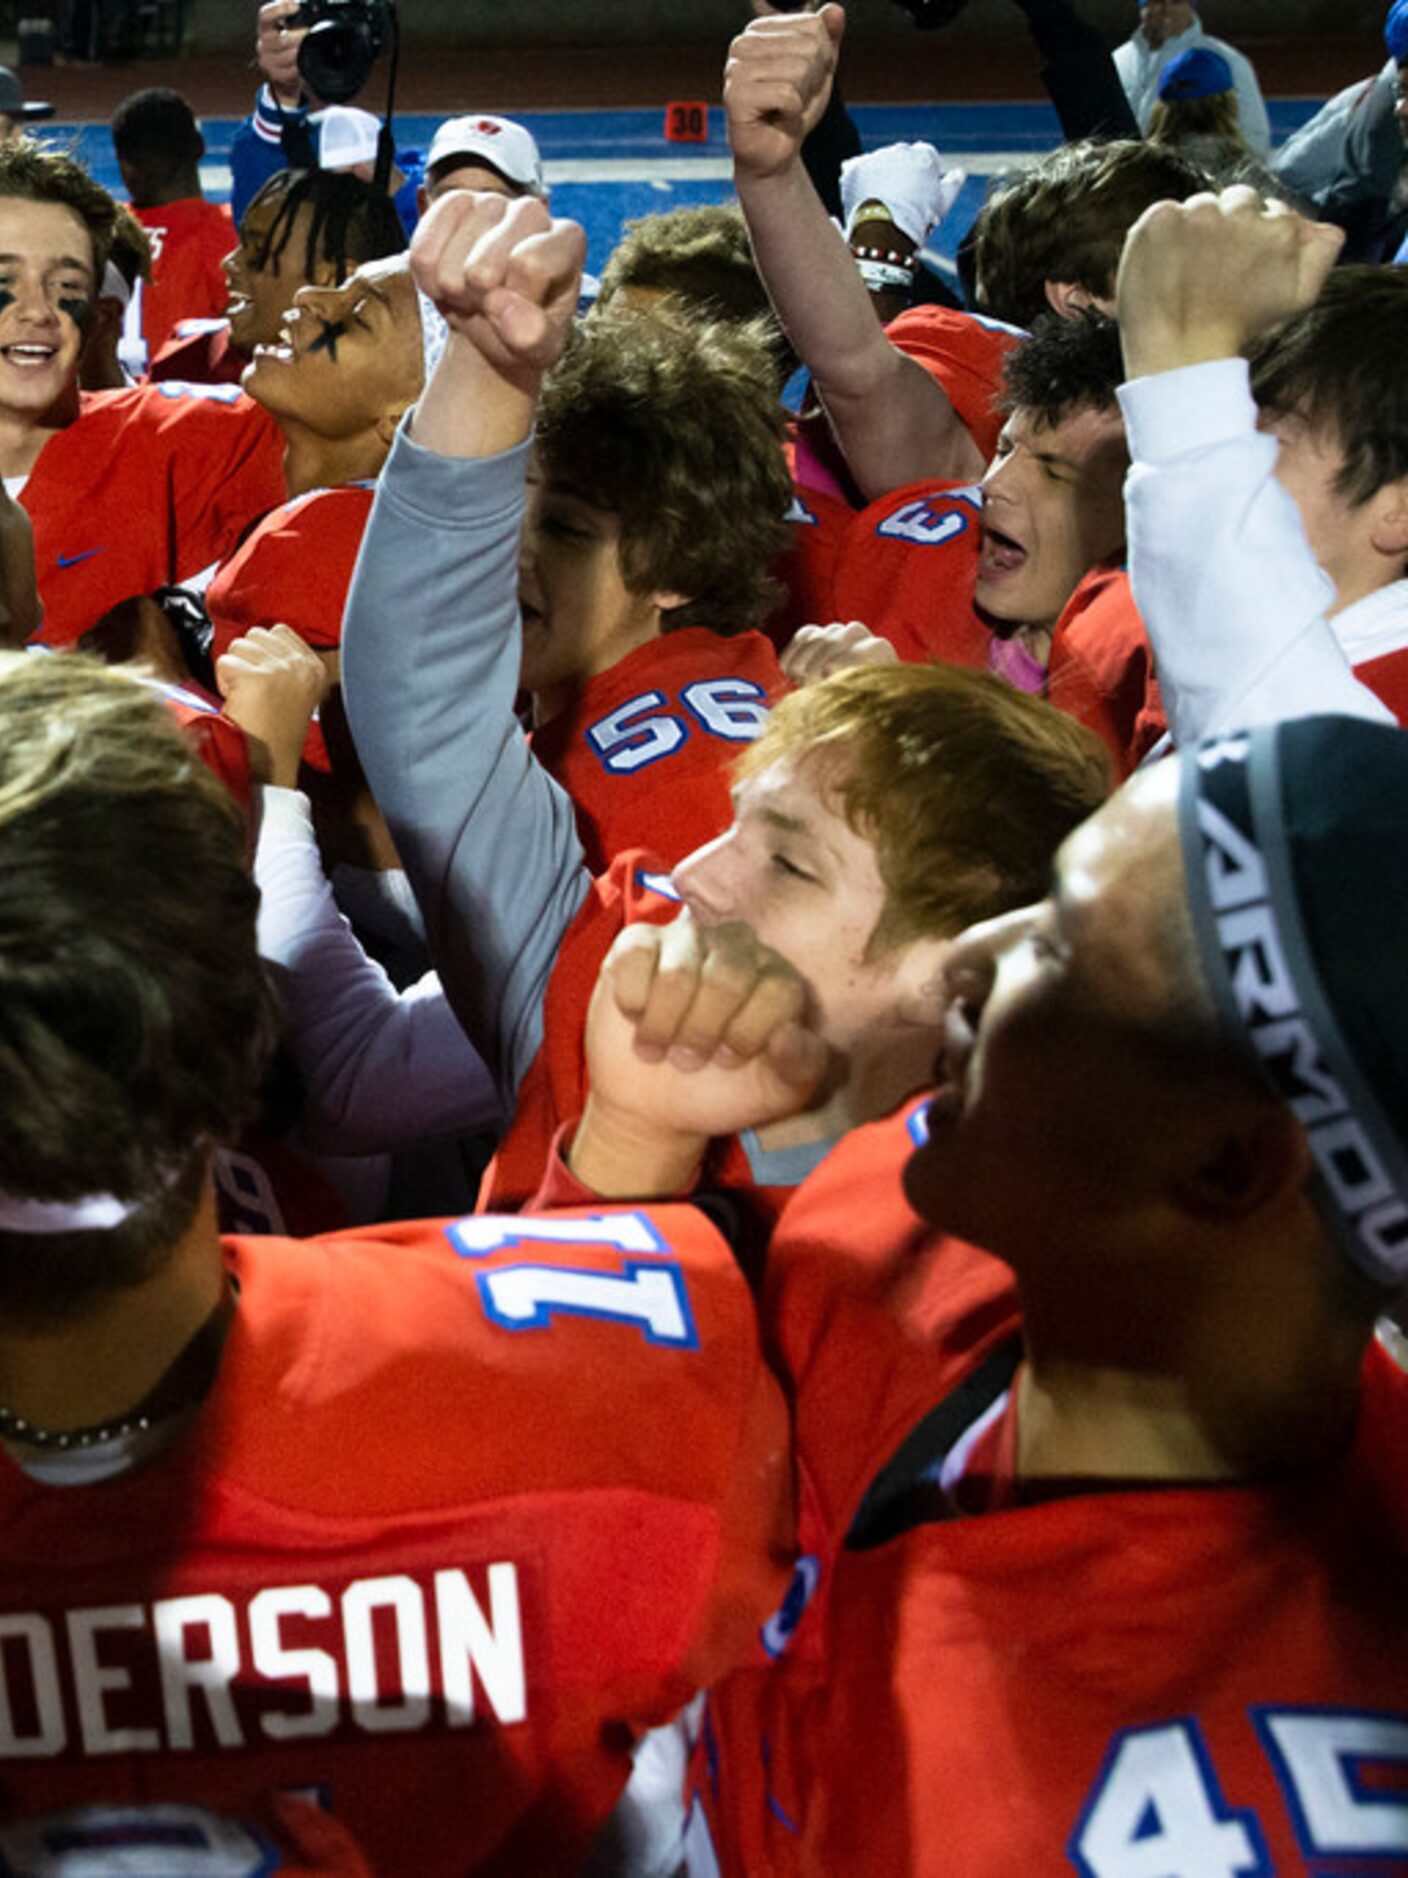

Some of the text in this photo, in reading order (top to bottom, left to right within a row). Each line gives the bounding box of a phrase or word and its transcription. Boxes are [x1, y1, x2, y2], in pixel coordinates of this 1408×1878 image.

[670, 107, 704, 136] 30
[585, 676, 772, 775] 56
[444, 1210, 701, 1351] 11
